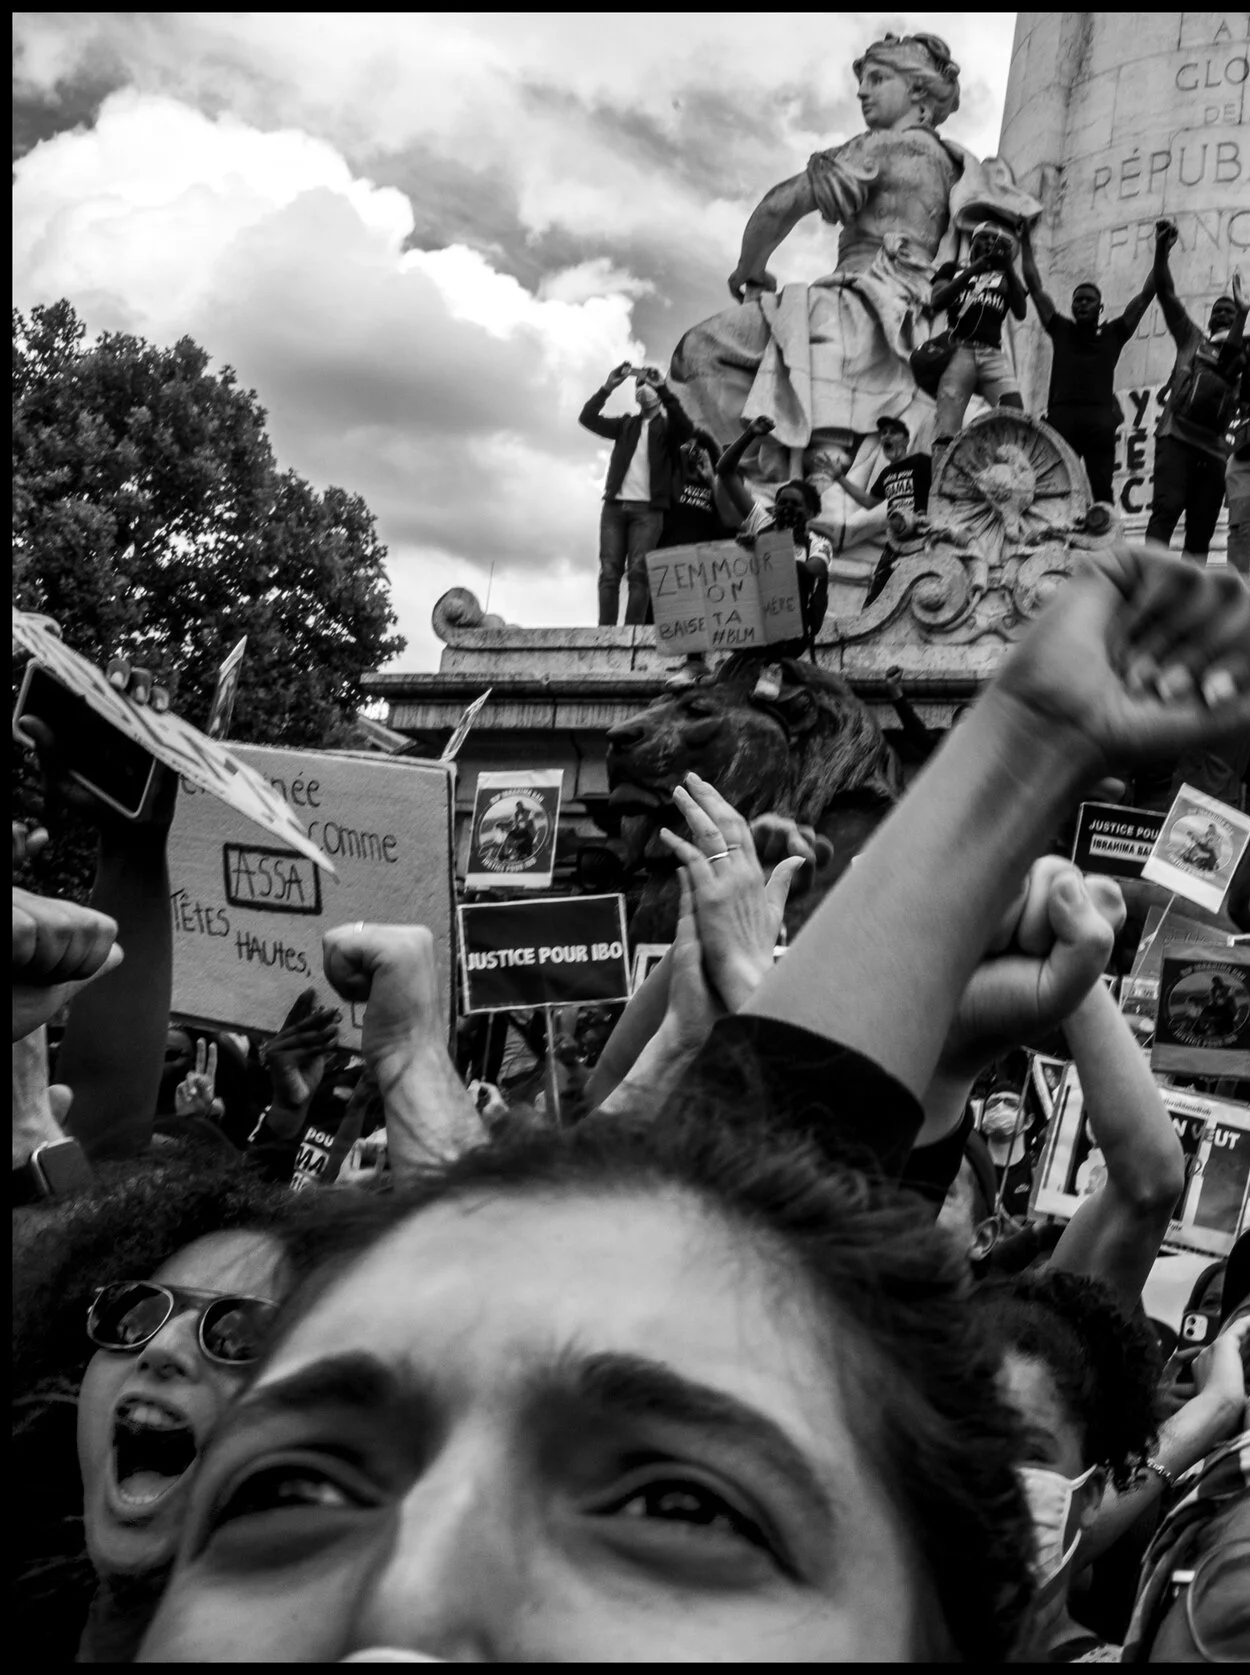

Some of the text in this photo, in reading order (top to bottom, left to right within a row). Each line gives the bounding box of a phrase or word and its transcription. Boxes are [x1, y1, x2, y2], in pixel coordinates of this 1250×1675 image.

[1203, 102, 1236, 125] DE
[651, 552, 773, 598] ZEMMOUR
[706, 579, 744, 603] ON
[658, 616, 706, 640] BAISE
[711, 609, 743, 626] TA
[1088, 818, 1160, 841] JUSTICE POU
[1093, 838, 1135, 855] IBRAHIMA
[231, 850, 305, 902] ASSA
[467, 940, 625, 971] JUSTICE POUR IBO
